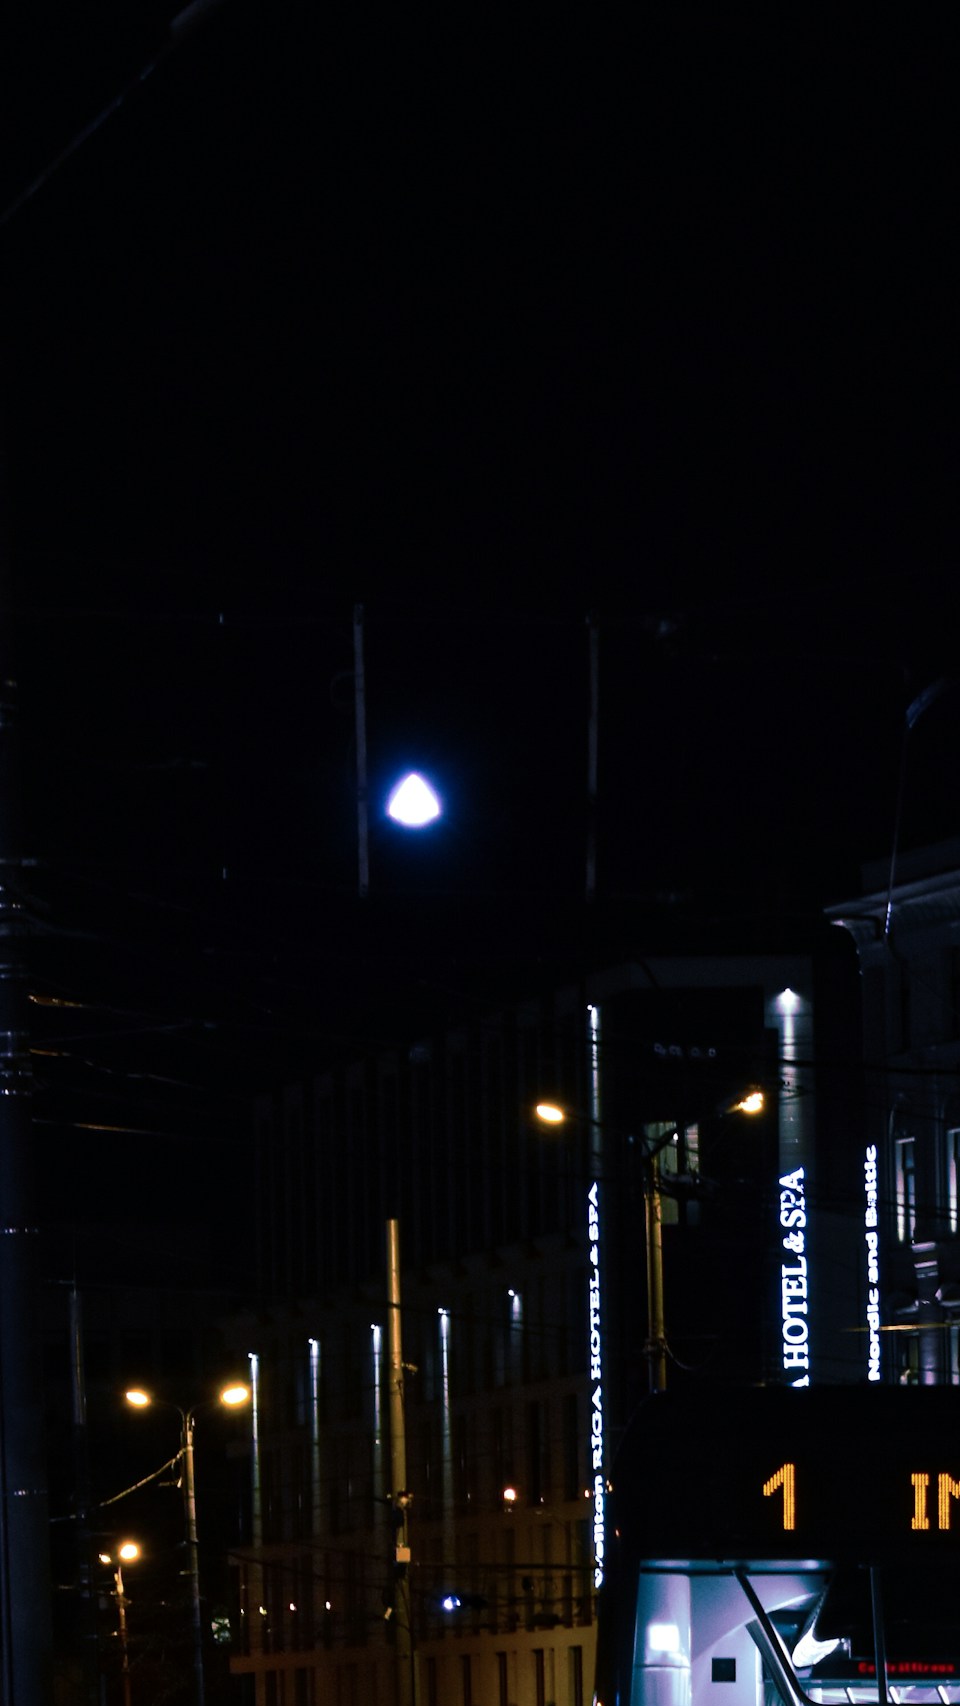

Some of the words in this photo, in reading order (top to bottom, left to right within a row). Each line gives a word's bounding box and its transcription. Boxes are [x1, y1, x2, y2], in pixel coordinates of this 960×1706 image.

[587, 1181, 600, 1242] SPA
[778, 1166, 807, 1228] SPA
[863, 1144, 878, 1228] Baltic
[782, 1229, 806, 1254] &
[865, 1231, 879, 1284] and
[589, 1267, 602, 1381] HOTEL
[781, 1254, 810, 1370] HOTEL
[867, 1287, 880, 1382] Nordic
[763, 1463, 795, 1530] 1
